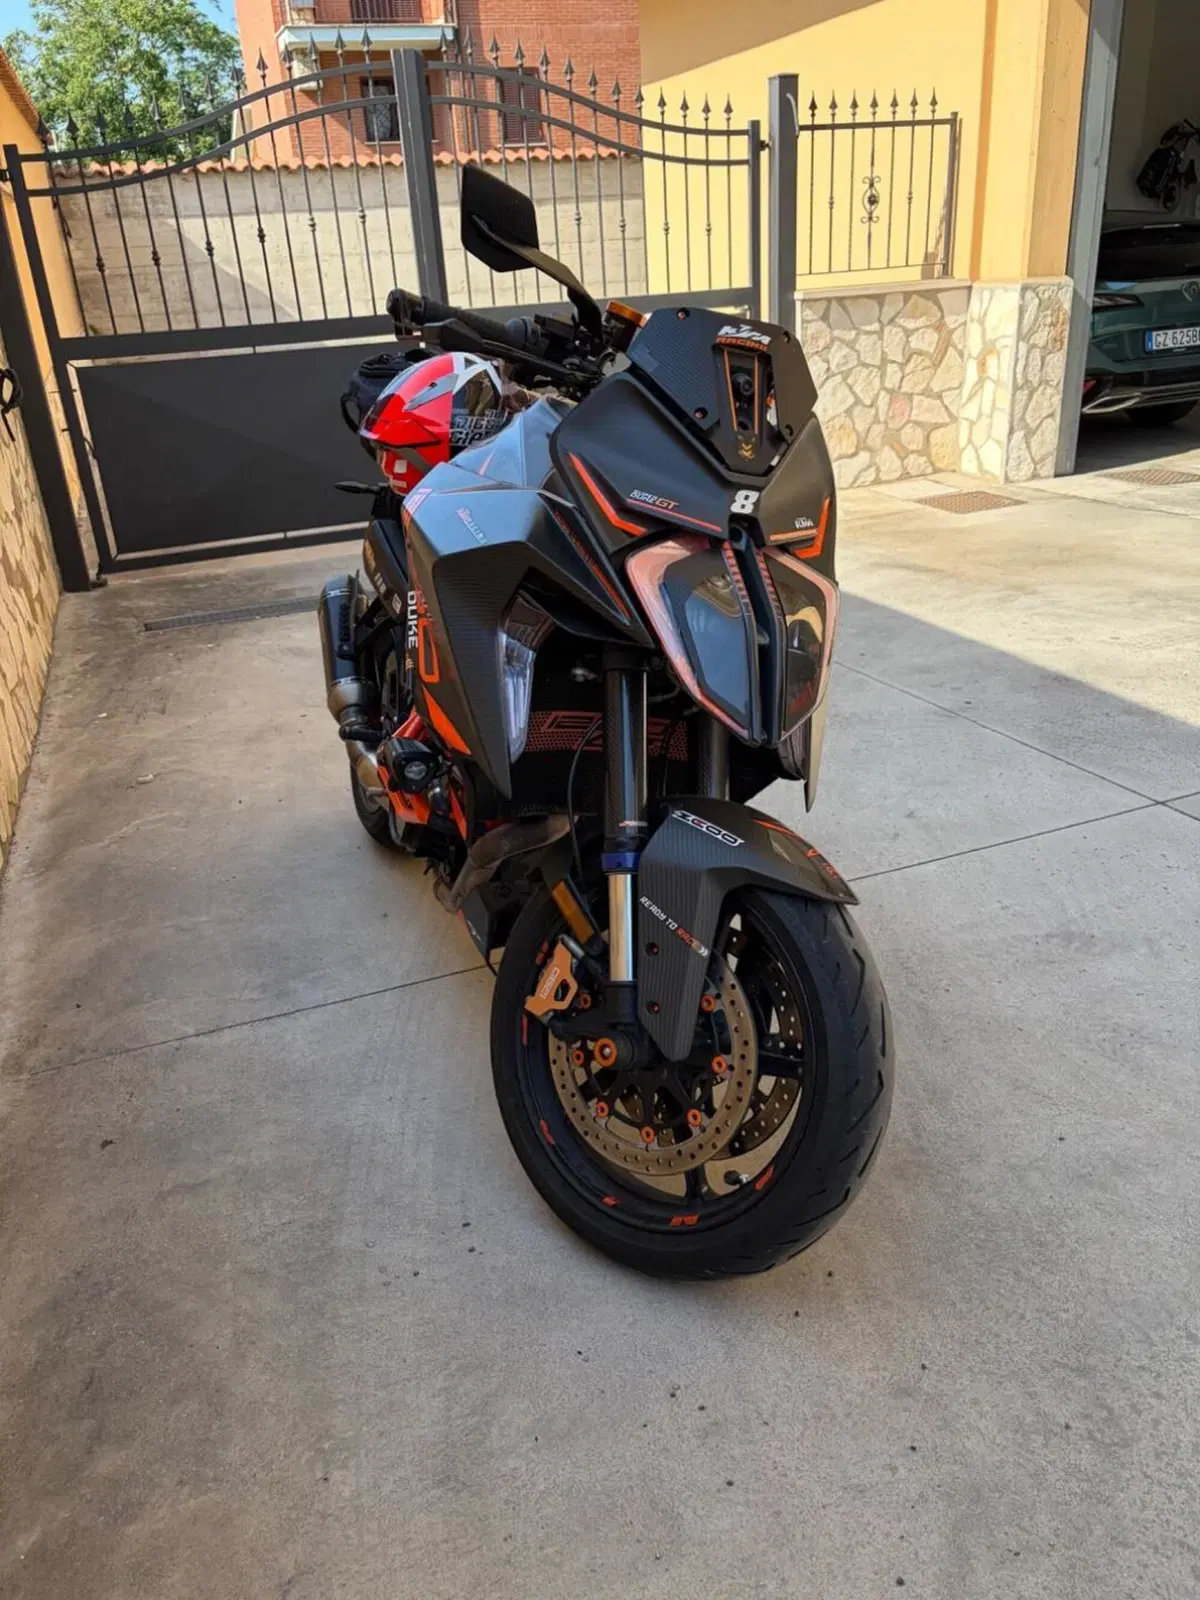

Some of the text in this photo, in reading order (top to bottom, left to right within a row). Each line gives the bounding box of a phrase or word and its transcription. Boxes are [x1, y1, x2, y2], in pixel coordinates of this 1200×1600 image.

[730, 489, 760, 514] 8
[407, 590, 419, 649] DUKE
[639, 895, 667, 922] READY
[665, 917, 678, 932] TO
